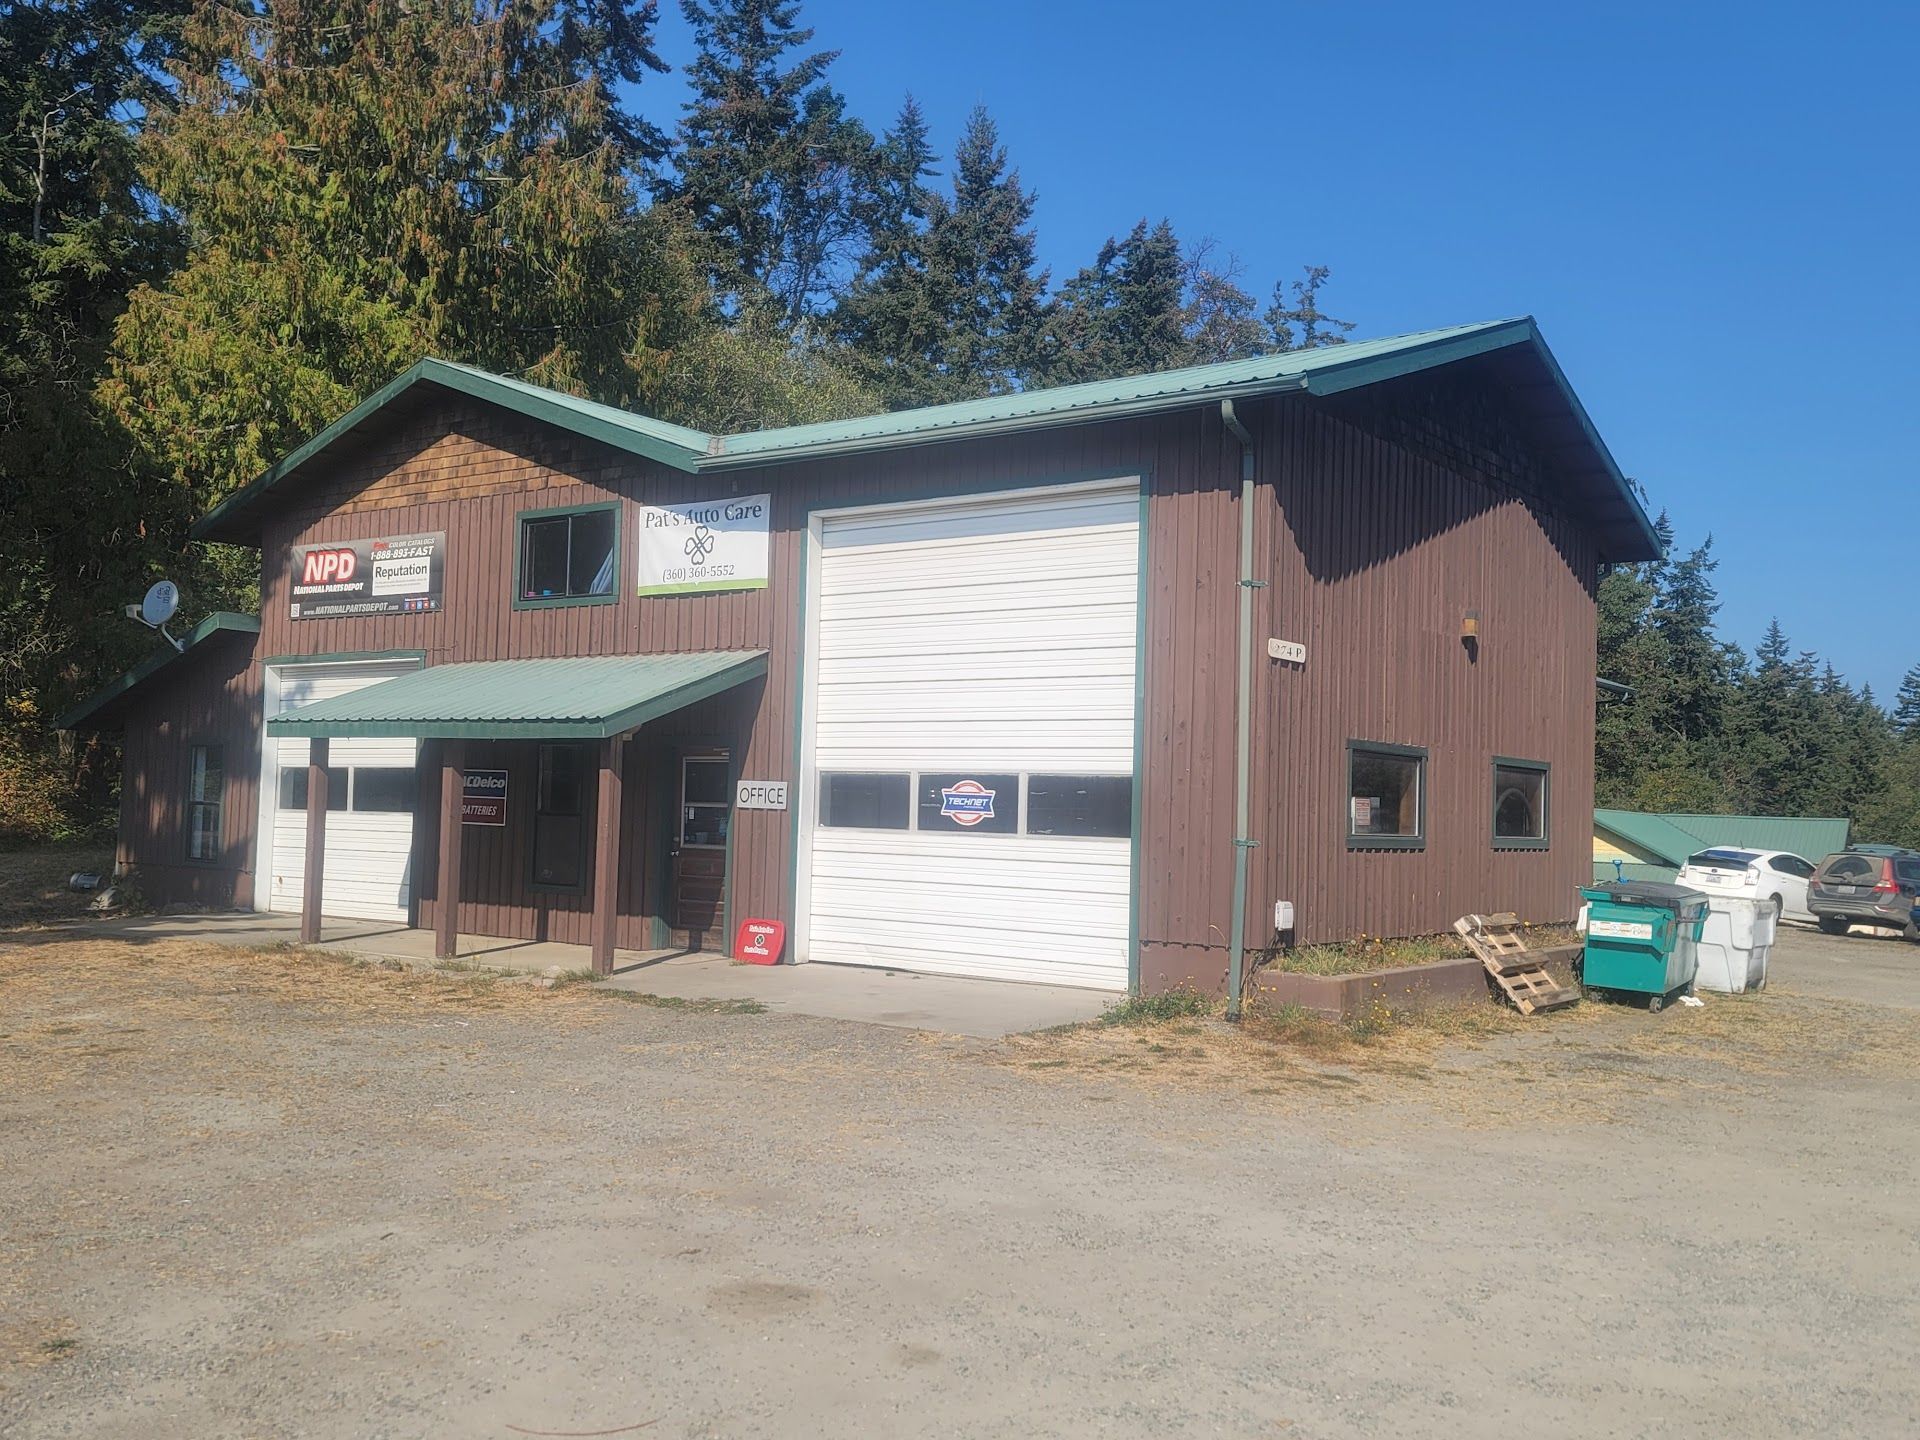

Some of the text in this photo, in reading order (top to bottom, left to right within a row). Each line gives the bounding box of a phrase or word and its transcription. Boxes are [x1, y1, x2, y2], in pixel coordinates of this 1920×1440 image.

[646, 504, 762, 528] Pat's Auto Care
[408, 538, 435, 546] CATALOGS
[370, 546, 434, 560] 1-888-893-FAST
[303, 550, 356, 583] NPD
[375, 564, 428, 580] Reputation
[662, 564, 735, 583] (360) 360-5552
[293, 585, 325, 595] NATIONAL
[325, 584, 344, 593] PARTS
[344, 582, 364, 592] DEPOT
[740, 787, 784, 805] OFFICE
